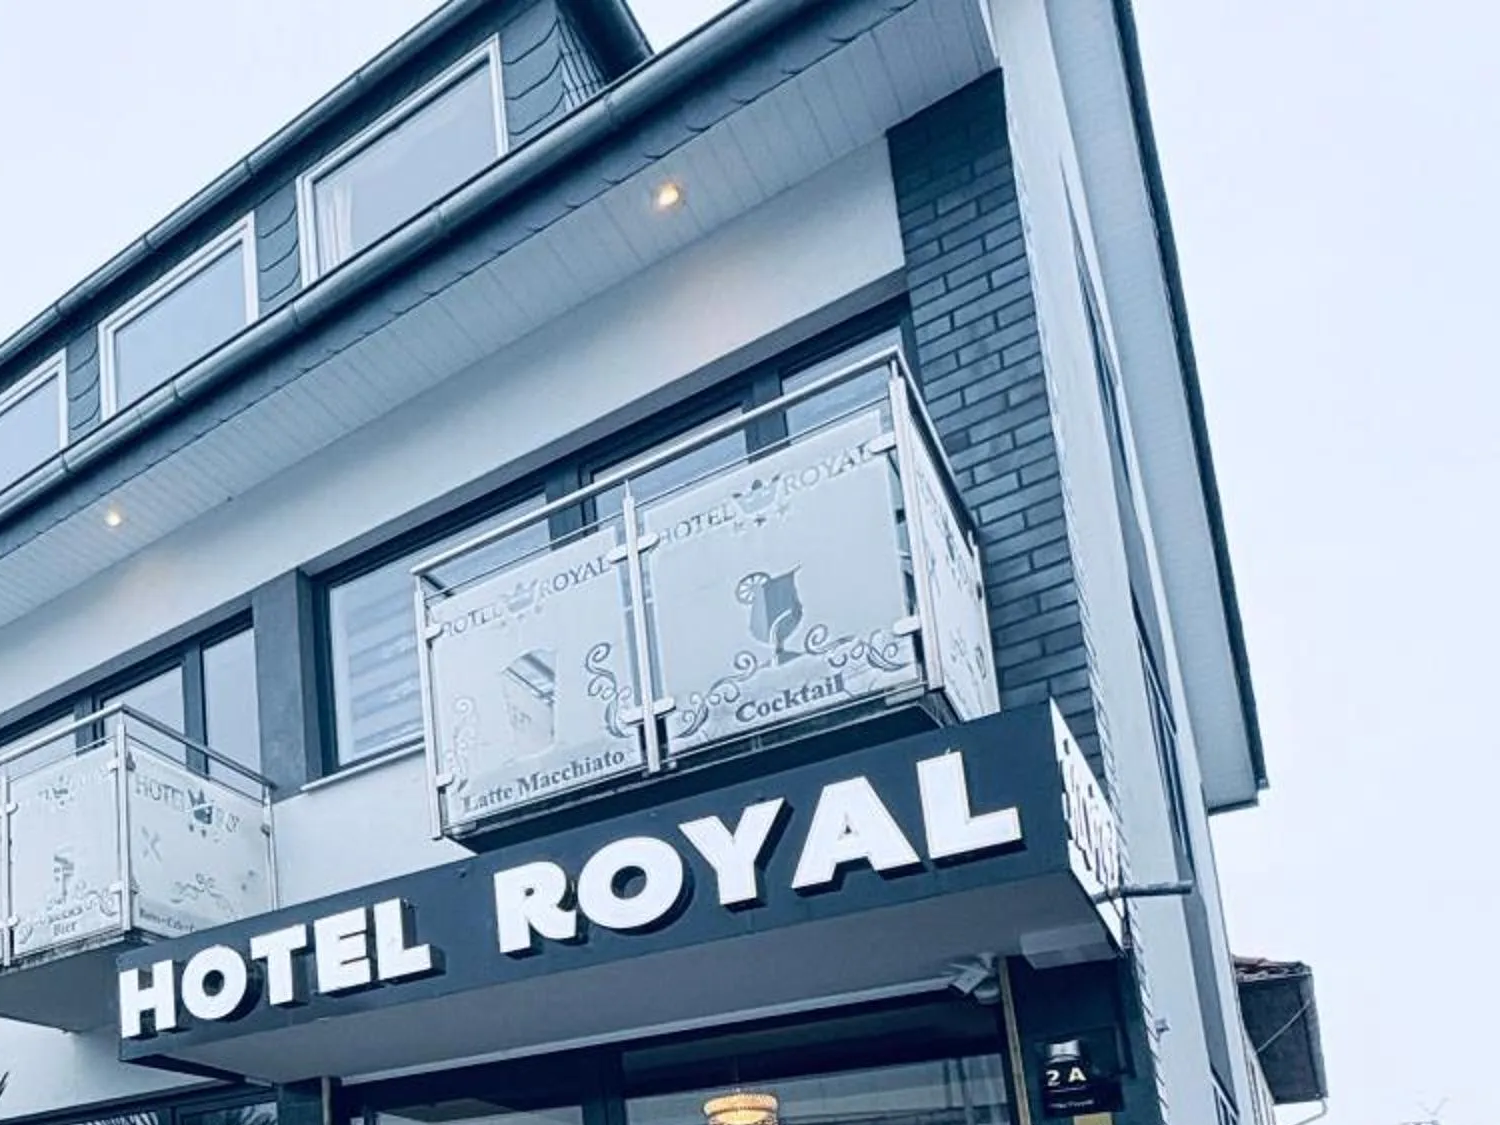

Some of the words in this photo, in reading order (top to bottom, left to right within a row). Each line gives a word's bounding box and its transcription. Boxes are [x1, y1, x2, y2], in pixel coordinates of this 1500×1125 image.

[656, 503, 737, 546] HOTEL
[781, 443, 873, 497] ROYAL
[443, 604, 505, 638] HOTEL
[539, 556, 613, 600] ROYAL
[735, 673, 846, 723] Cocktail
[461, 784, 514, 813] Latte
[517, 749, 626, 801] Macchiato
[119, 897, 431, 1039] HOTEL
[493, 751, 1023, 953] ROYAL
